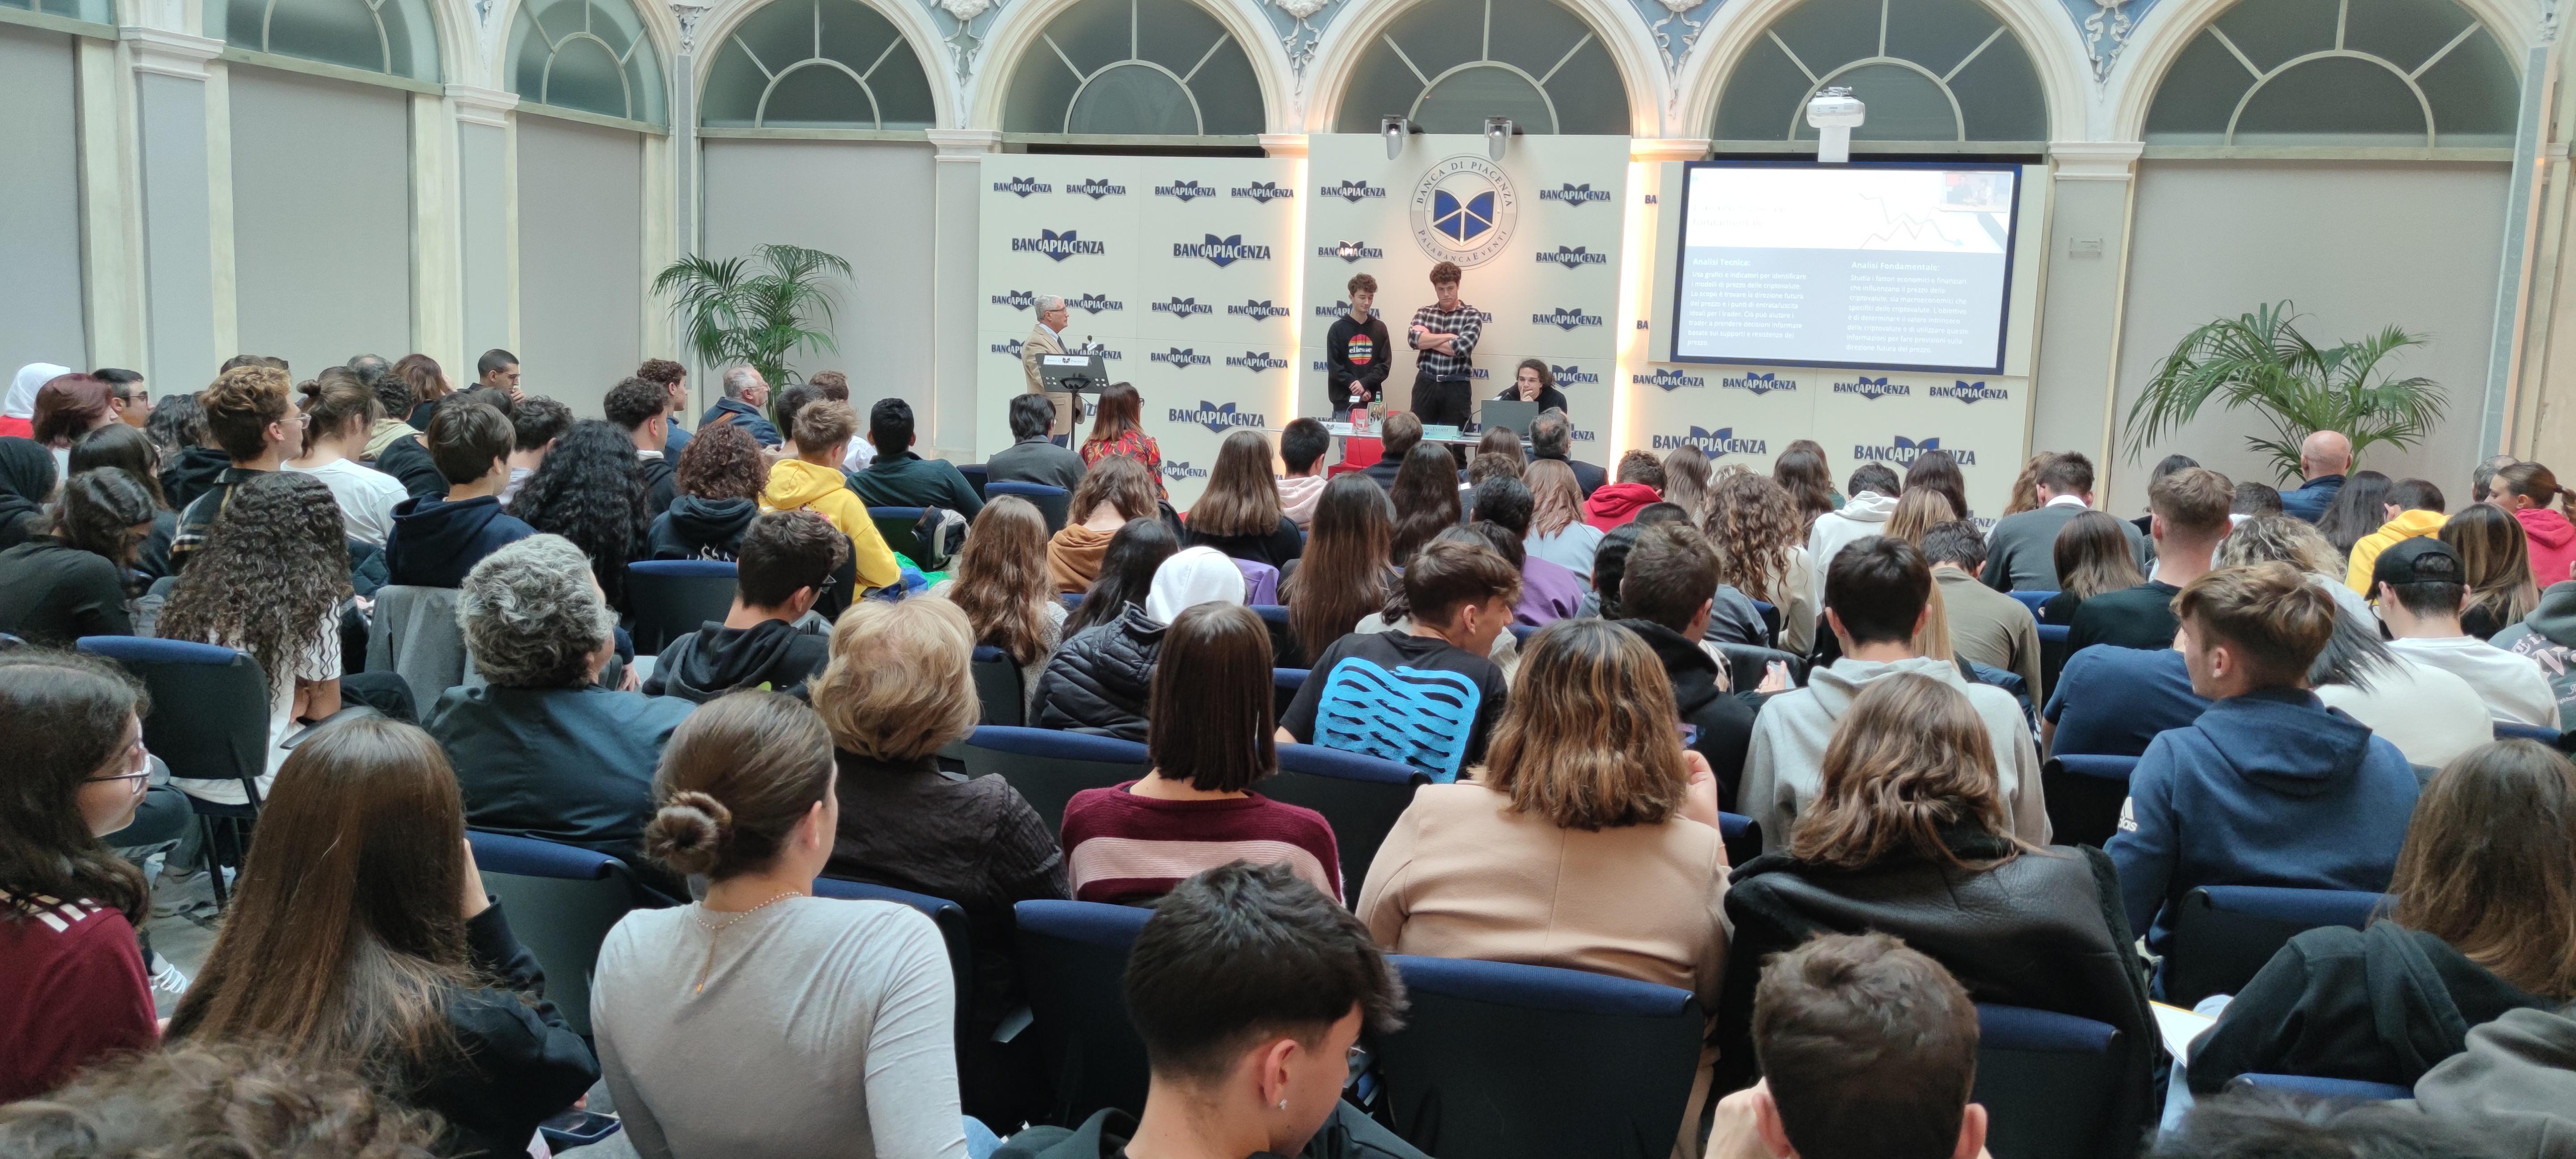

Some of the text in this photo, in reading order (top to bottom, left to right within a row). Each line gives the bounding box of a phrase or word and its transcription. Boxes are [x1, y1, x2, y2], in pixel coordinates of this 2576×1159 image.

[994, 182, 1052, 193] BANCAPIACENZA
[1066, 184, 1126, 195] BANCAPIACENZA
[1417, 161, 1513, 207] BANCA DI PIACENZA
[1154, 186, 1216, 197] BANCAPIACENZA
[1231, 187, 1294, 198] BANCAPIACENZA
[1320, 186, 1386, 197] BANCAPIACENZA
[1539, 190, 1610, 201] BANCAPIACENZA
[1012, 238, 1105, 255] BANCAPIACENZA
[1173, 243, 1271, 260] BANCAPIACENZA
[1318, 247, 1383, 258] BANCAPIACENZA
[1536, 252, 1606, 263] BANCAPIACENZA
[1693, 258, 1718, 266] Analisi
[1880, 262, 1940, 271] Fondamentale:
[1152, 303, 1212, 314] BANCAPIACENZA
[1227, 305, 1290, 317] BANCAPIACENZA
[1532, 313, 1602, 326] BANCAPIACENZA
[1928, 317, 1961, 325] intrinseco
[1151, 352, 1211, 365] BANCAPIACENZA
[1226, 356, 1288, 369] BANCAPIACENZA
[1553, 372, 1598, 383] APIACENZA
[1633, 375, 1704, 386] BANCAPIACENZA
[1723, 378, 1796, 390] BANCAPIACENZA
[1834, 383, 1910, 394] BANCAPIACENZA
[1929, 387, 2008, 399] BANCAPIACENZA
[1169, 408, 1264, 428] BANCAPIACENZA
[1163, 467, 1207, 477] CAPIACENZA
[2118, 816, 2137, 831] das
